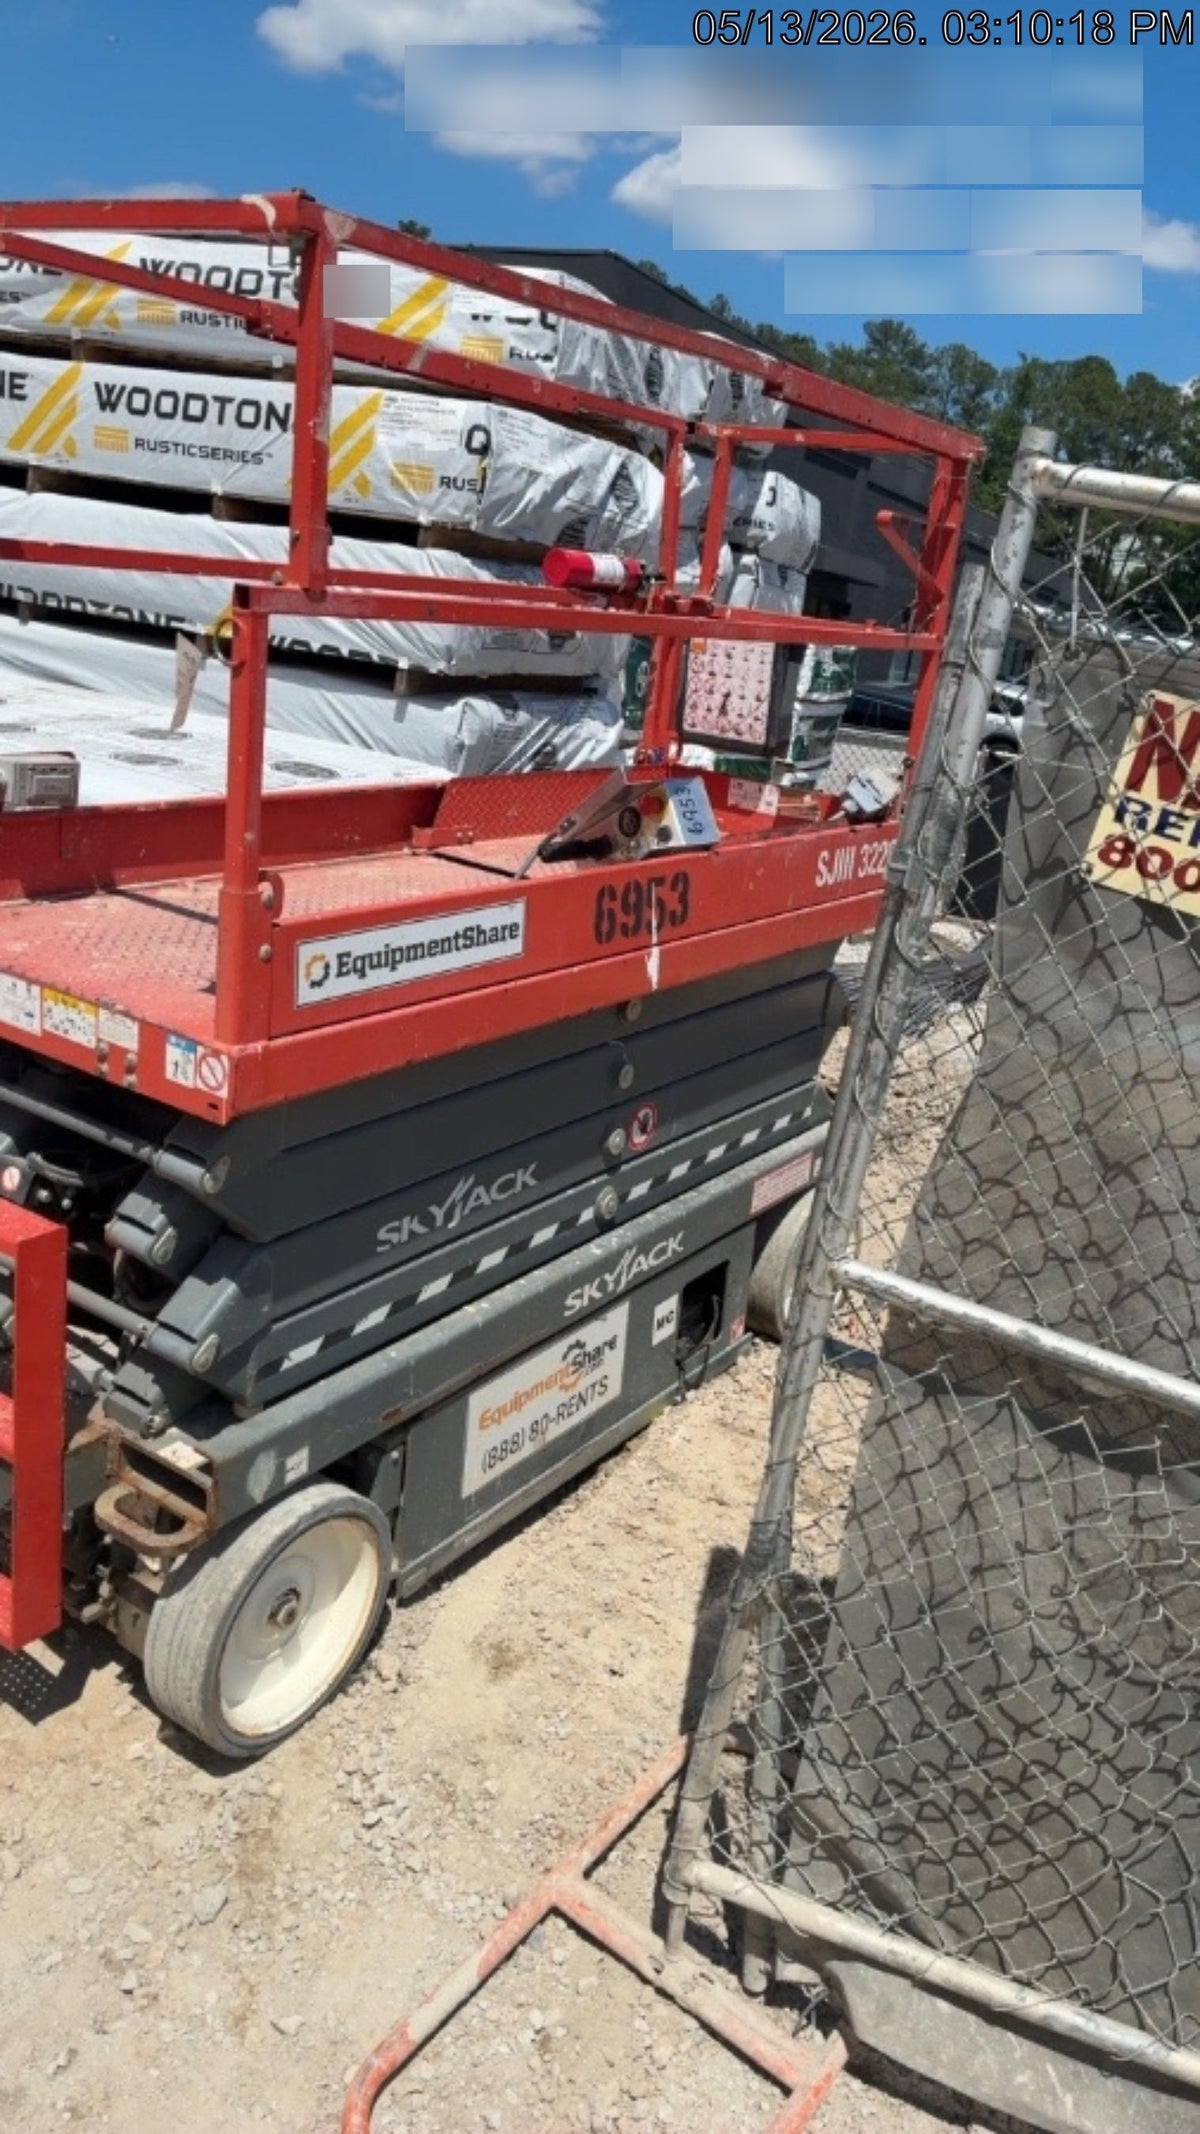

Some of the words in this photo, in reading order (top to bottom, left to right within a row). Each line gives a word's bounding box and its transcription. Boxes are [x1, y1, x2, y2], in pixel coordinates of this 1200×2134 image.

[138, 256, 300, 300] WOODT
[94, 381, 295, 433] WOODTON
[439, 475, 480, 493] RUS
[675, 786, 704, 836] 6953
[594, 868, 690, 945] 6953
[335, 921, 520, 979] EquipmentShare
[376, 1161, 540, 1253] SKYJACK
[563, 1230, 685, 1318] SKYJACK
[481, 1430, 525, 1475] (888)
[528, 1374, 609, 1443] 80-RENTS
